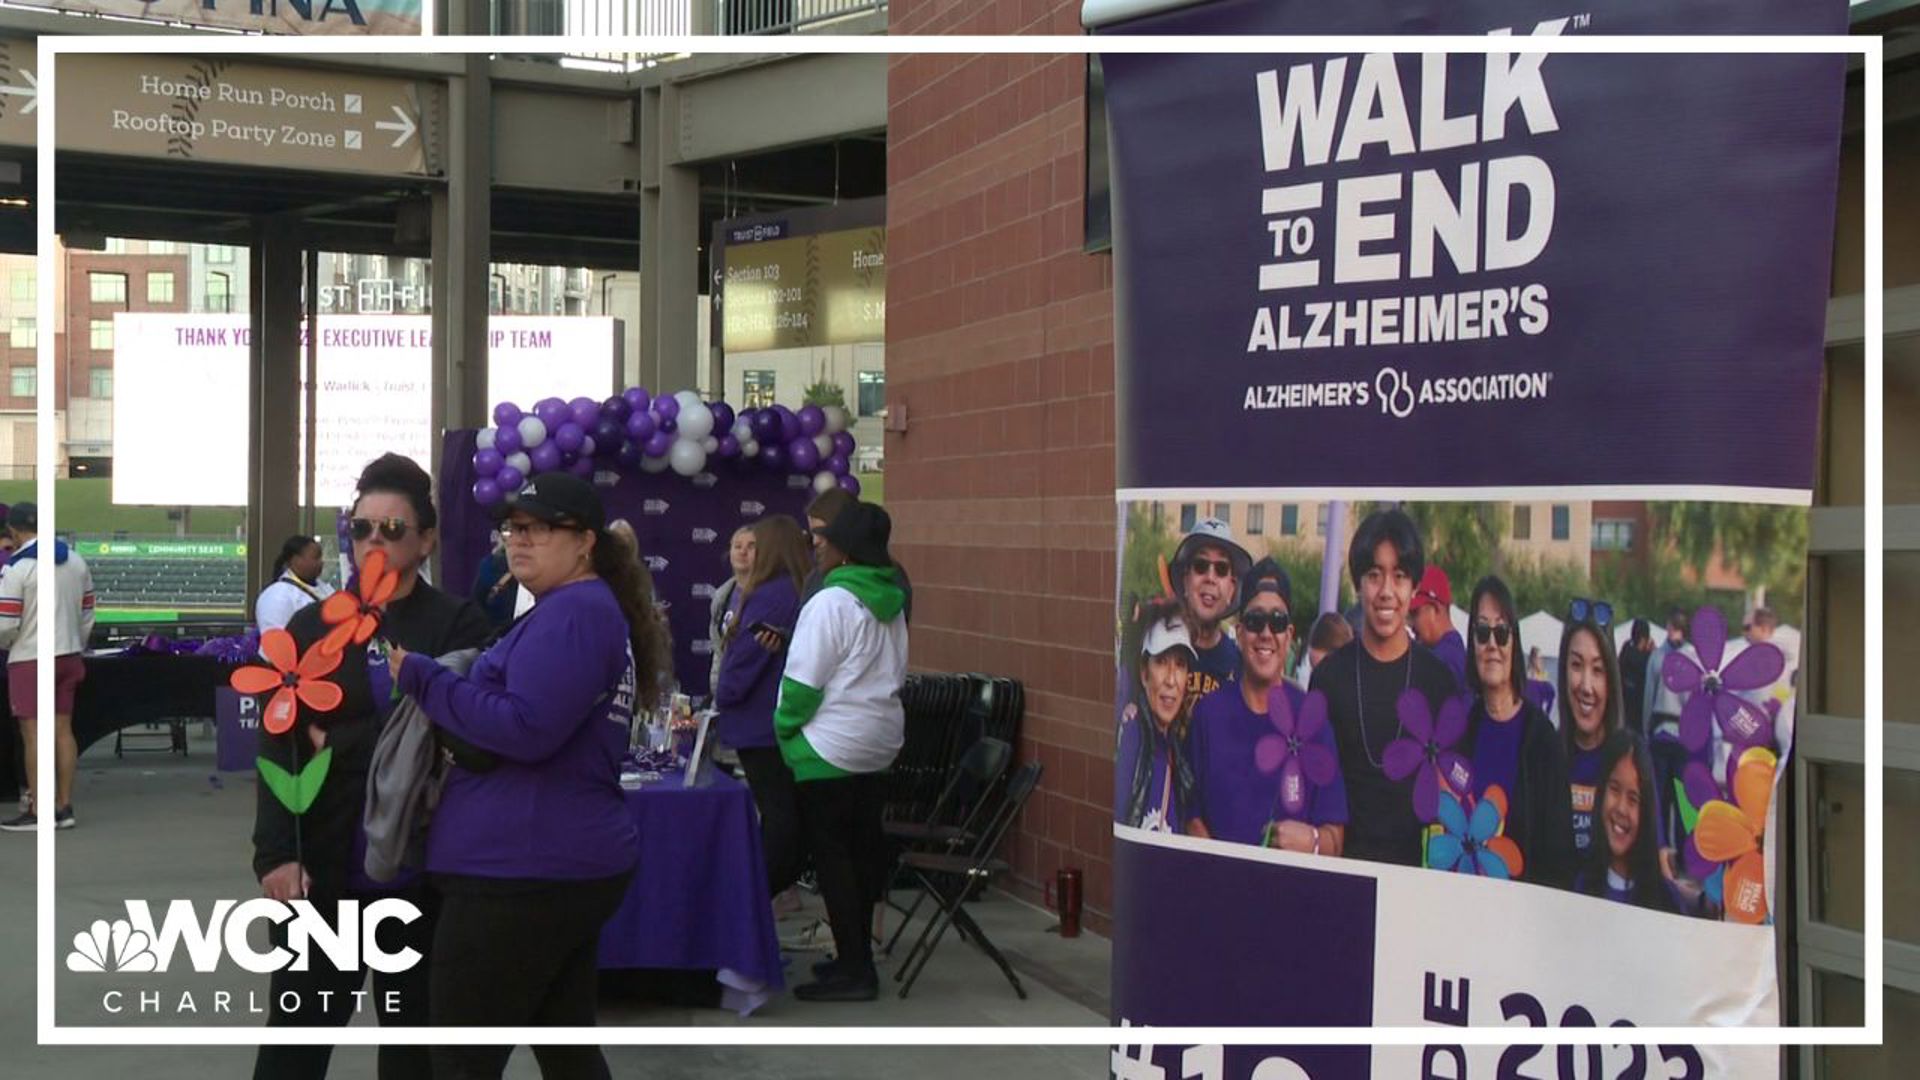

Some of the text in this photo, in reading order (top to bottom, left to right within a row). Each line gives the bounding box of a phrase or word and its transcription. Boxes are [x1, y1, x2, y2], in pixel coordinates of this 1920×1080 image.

[140, 75, 335, 112] Home Run Porch
[1256, 17, 1571, 172] WALK
[112, 109, 336, 148] Rooftop Party Zone
[1267, 155, 1556, 284] TO END
[728, 264, 780, 282] Section 103
[853, 250, 884, 268] Home
[1247, 283, 1549, 352] ALZHEIMER'S
[176, 328, 227, 346] THANK
[323, 329, 405, 347] EXECUTIVE
[511, 330, 552, 348] TEAM
[1244, 373, 1547, 409] ALZHEIMER'S ASSOCIATION
